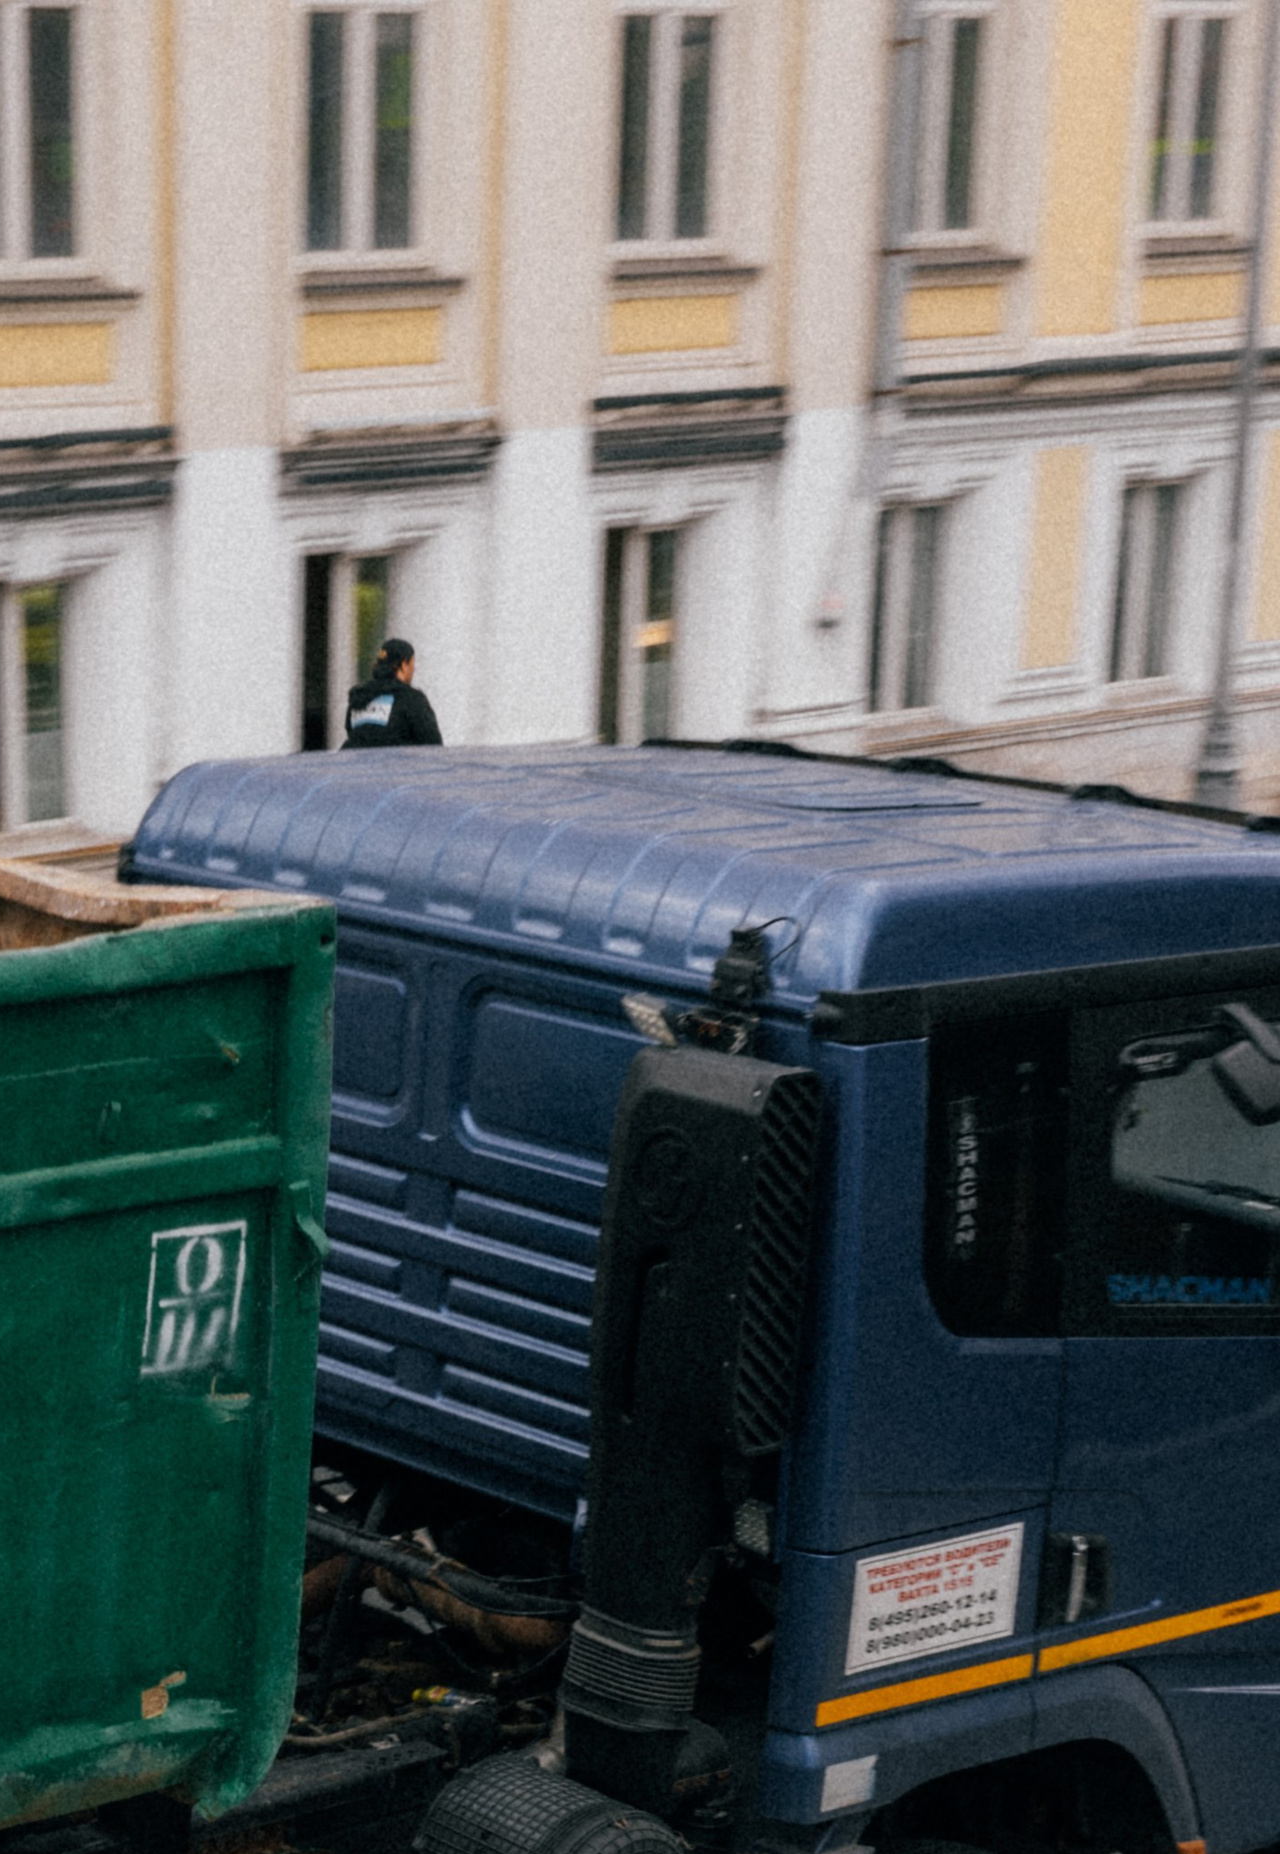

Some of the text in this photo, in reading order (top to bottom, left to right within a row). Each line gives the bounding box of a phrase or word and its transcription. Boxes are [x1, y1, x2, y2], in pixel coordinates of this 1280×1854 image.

[954, 1134, 979, 1245] SHACMAN
[867, 1538, 1010, 1577] ТРЕБУЮТСЯ ВОДИТЕЛИ
[868, 1568, 941, 1594] КАТЕГОРИИ
[897, 1583, 939, 1603] ВАХТА
